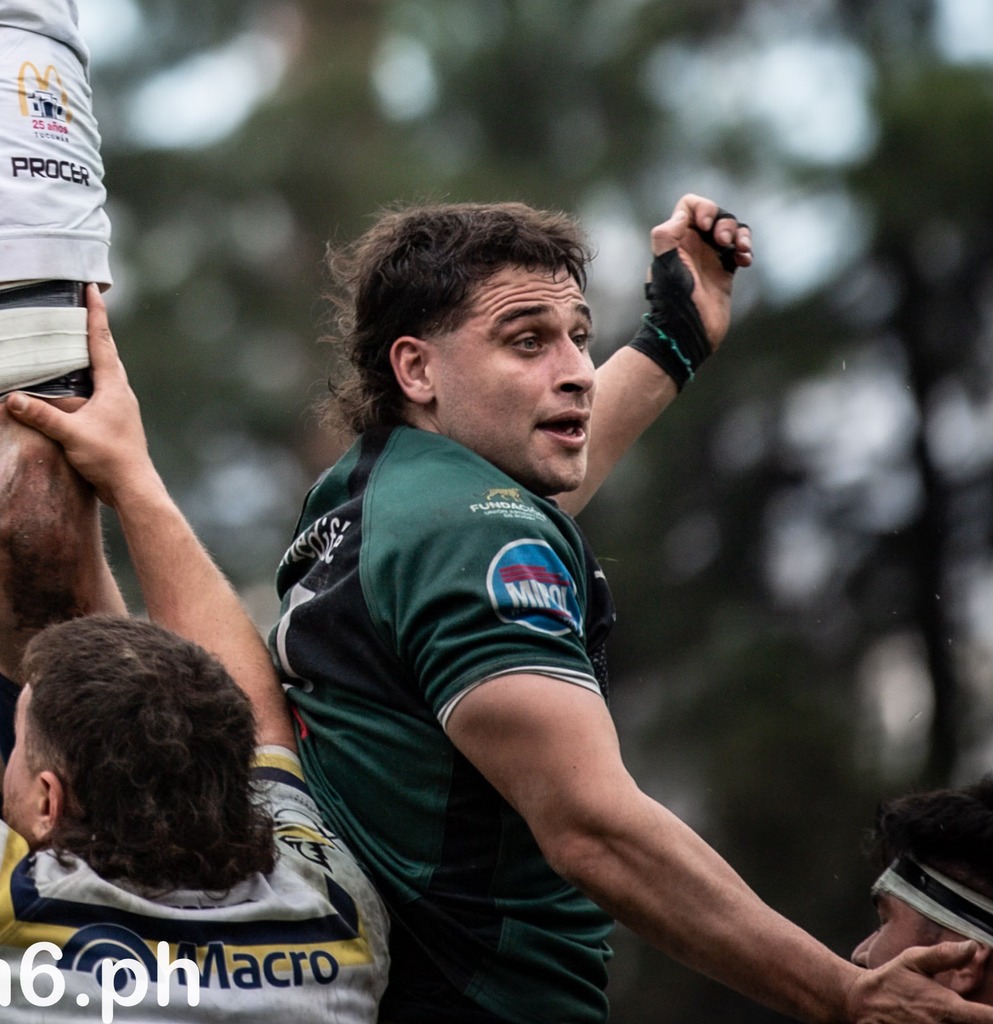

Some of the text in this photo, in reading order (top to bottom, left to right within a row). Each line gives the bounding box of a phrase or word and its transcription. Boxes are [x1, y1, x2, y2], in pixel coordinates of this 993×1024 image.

[32, 119, 70, 135] 25 años
[11, 156, 90, 187] PROCER
[174, 940, 340, 992] Macro
